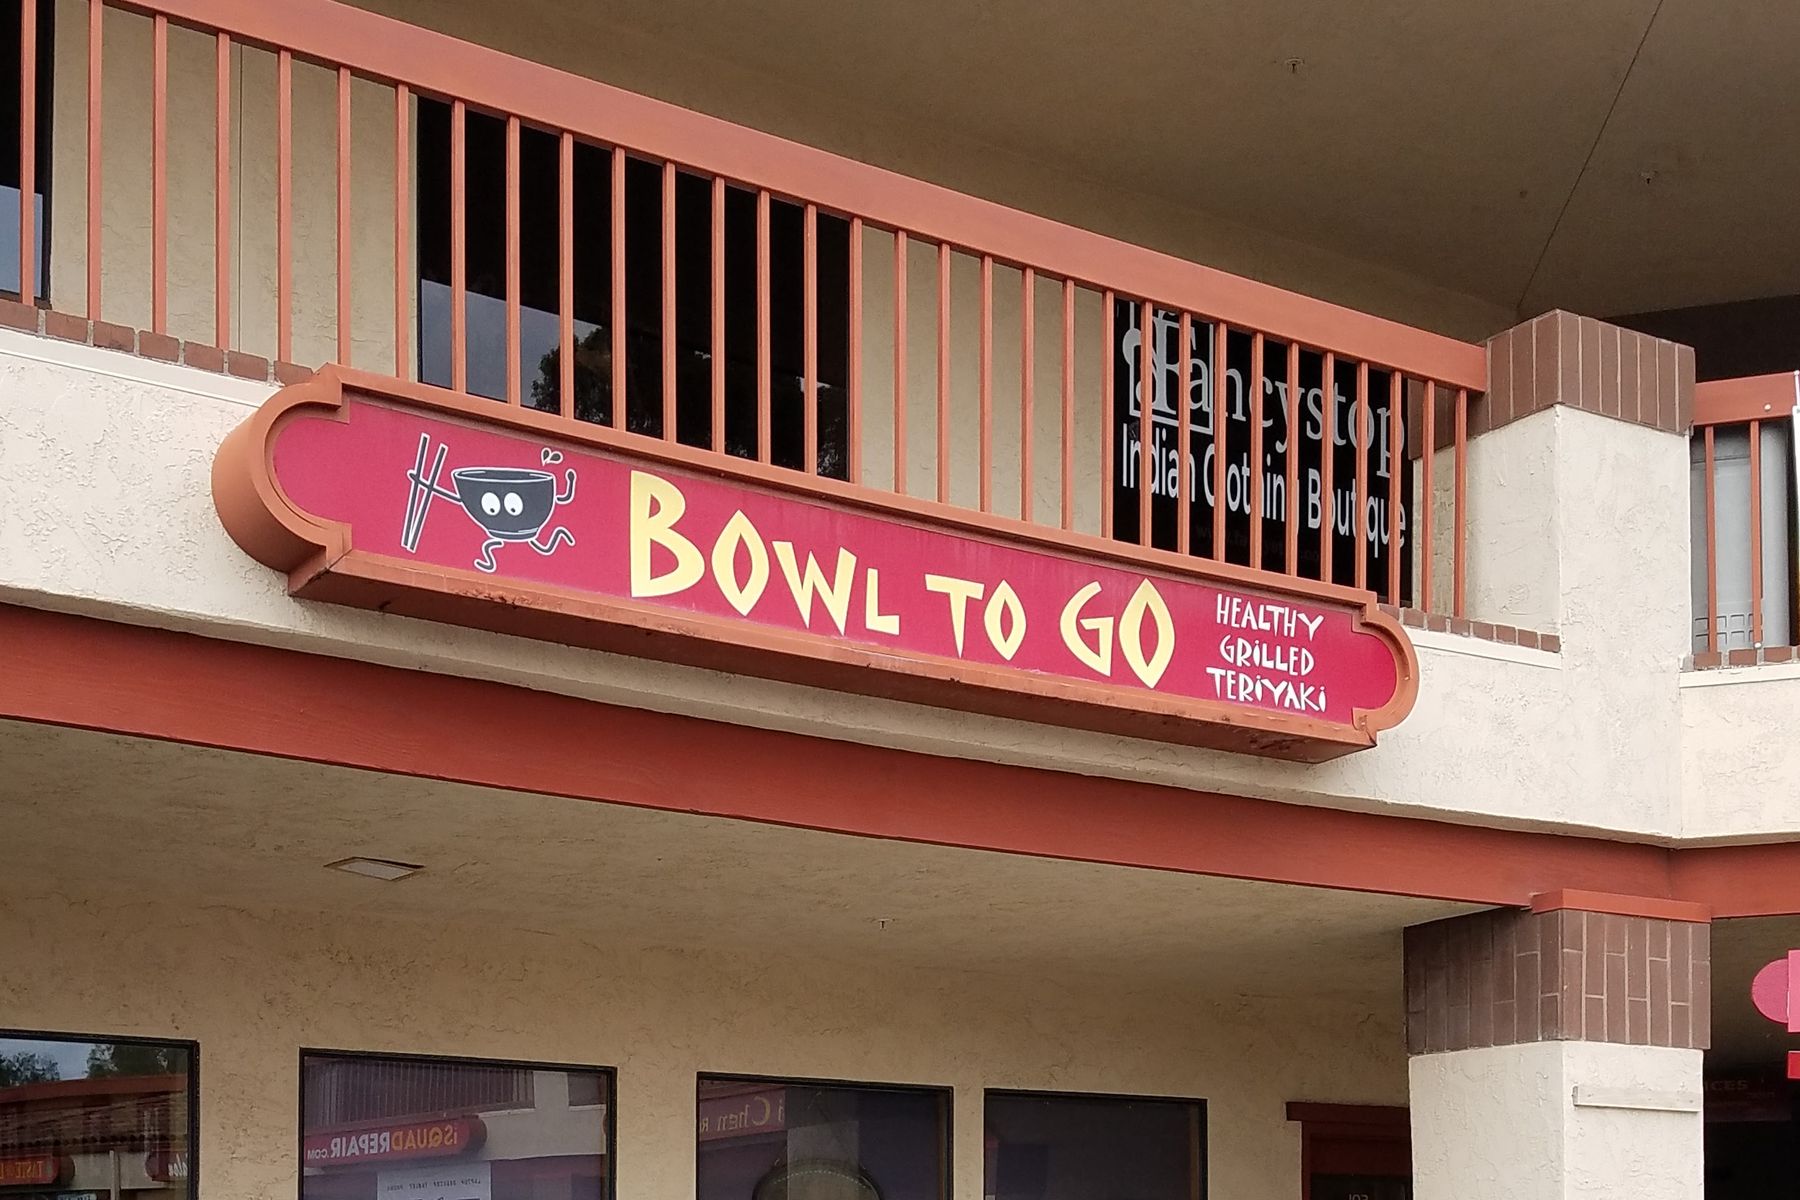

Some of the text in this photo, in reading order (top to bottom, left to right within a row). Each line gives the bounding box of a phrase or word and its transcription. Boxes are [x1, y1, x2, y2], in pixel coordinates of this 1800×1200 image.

[629, 470, 1176, 689] BOWL TO GO
[1216, 593, 1325, 642] HEALTHY
